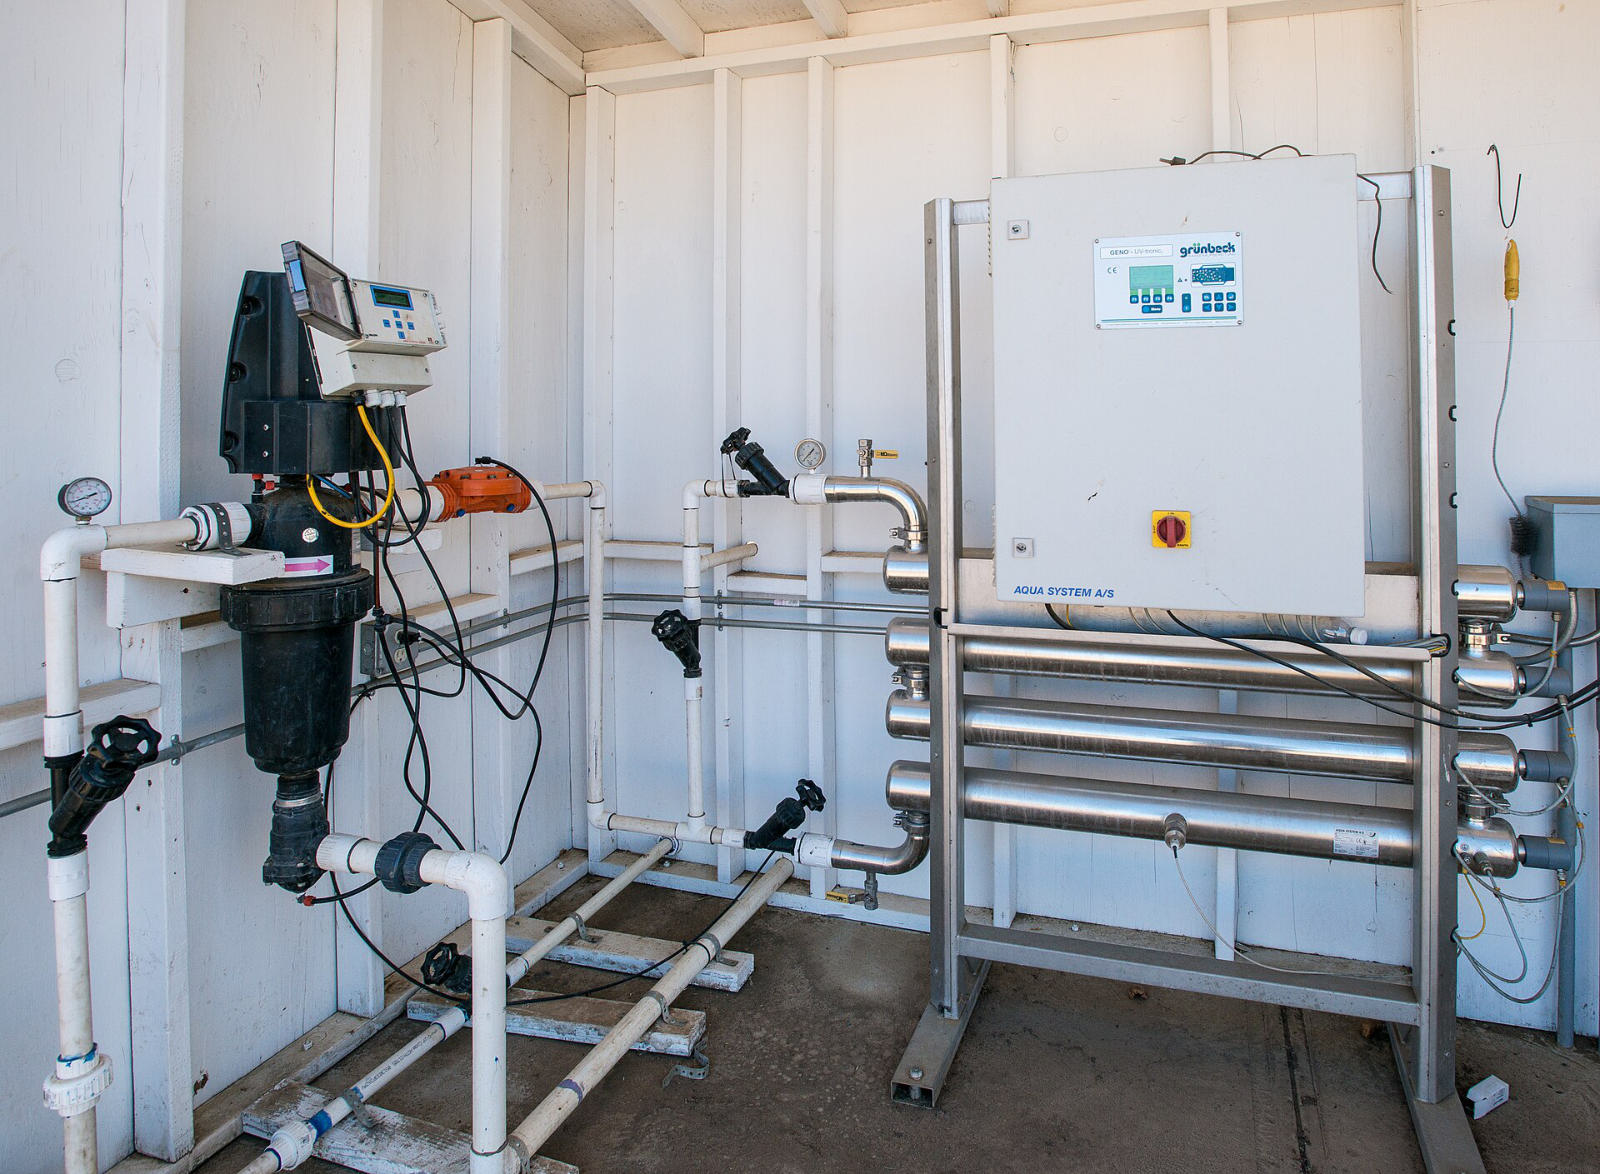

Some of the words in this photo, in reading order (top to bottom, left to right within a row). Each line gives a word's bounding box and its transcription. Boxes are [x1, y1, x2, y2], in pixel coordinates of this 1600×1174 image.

[1180, 242, 1236, 258] grünbeck
[1014, 586, 1044, 595] AQUA
[1047, 586, 1092, 597] SYSTEM
[1094, 589, 1115, 598] A/S
